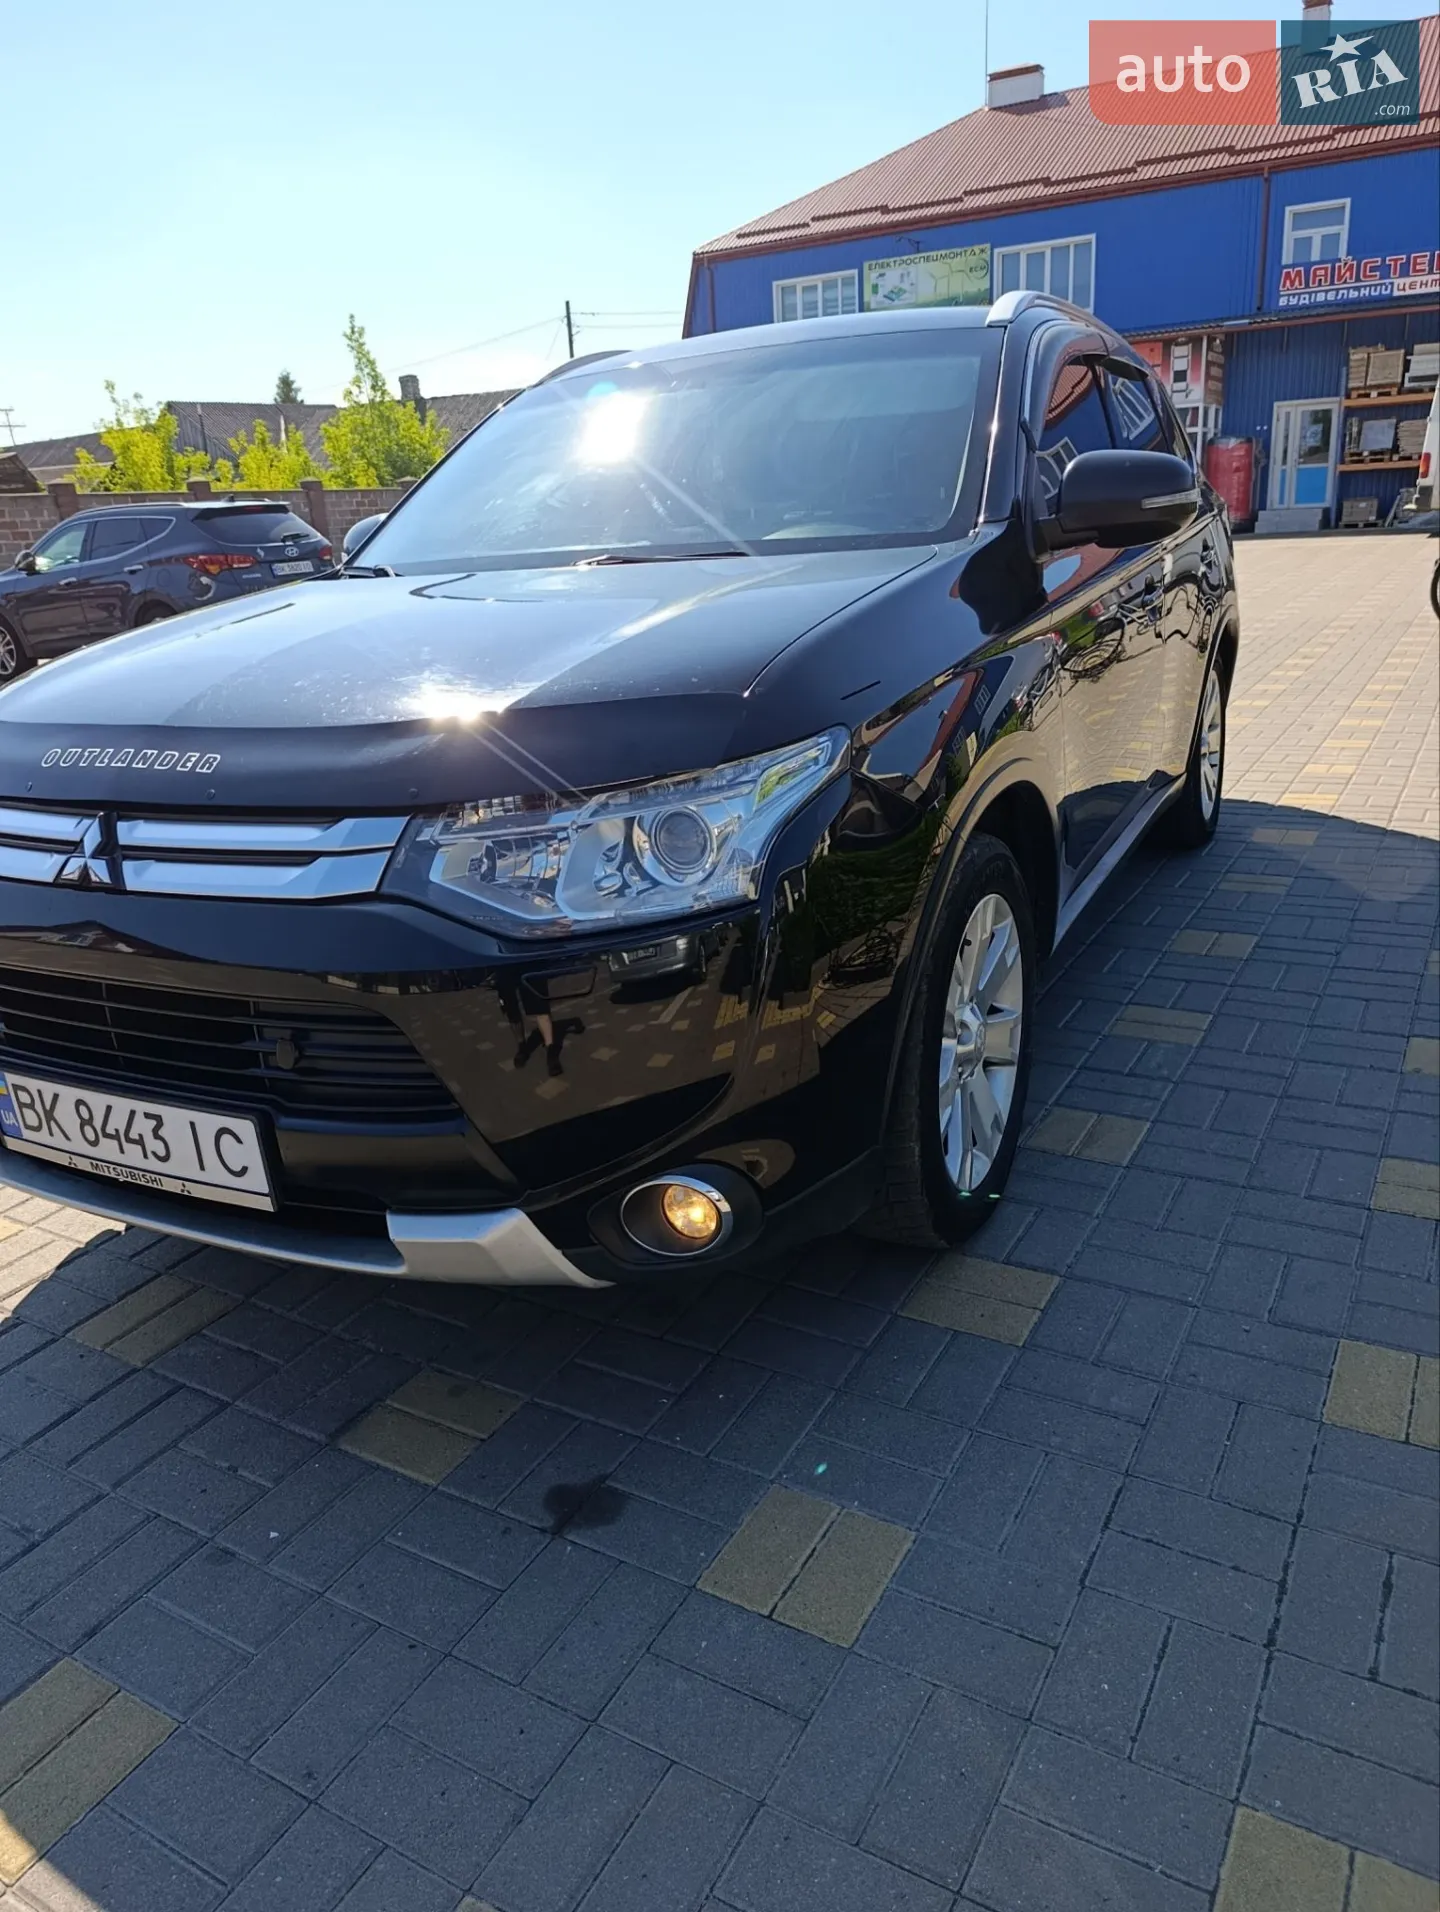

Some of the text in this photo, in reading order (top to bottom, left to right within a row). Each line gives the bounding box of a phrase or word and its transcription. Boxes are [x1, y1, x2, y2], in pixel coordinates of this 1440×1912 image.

[867, 246, 988, 271] ЕЛЕКТРОСПЕЦМОНТАЖ
[1278, 282, 1393, 306] БУДІВЕЛЬНИЙ
[41, 748, 221, 773] OUTLANDER
[0, 1109, 19, 1127] UA
[11, 1083, 249, 1178] BK 8443 IC
[89, 1161, 164, 1188] MITSUBISHI
